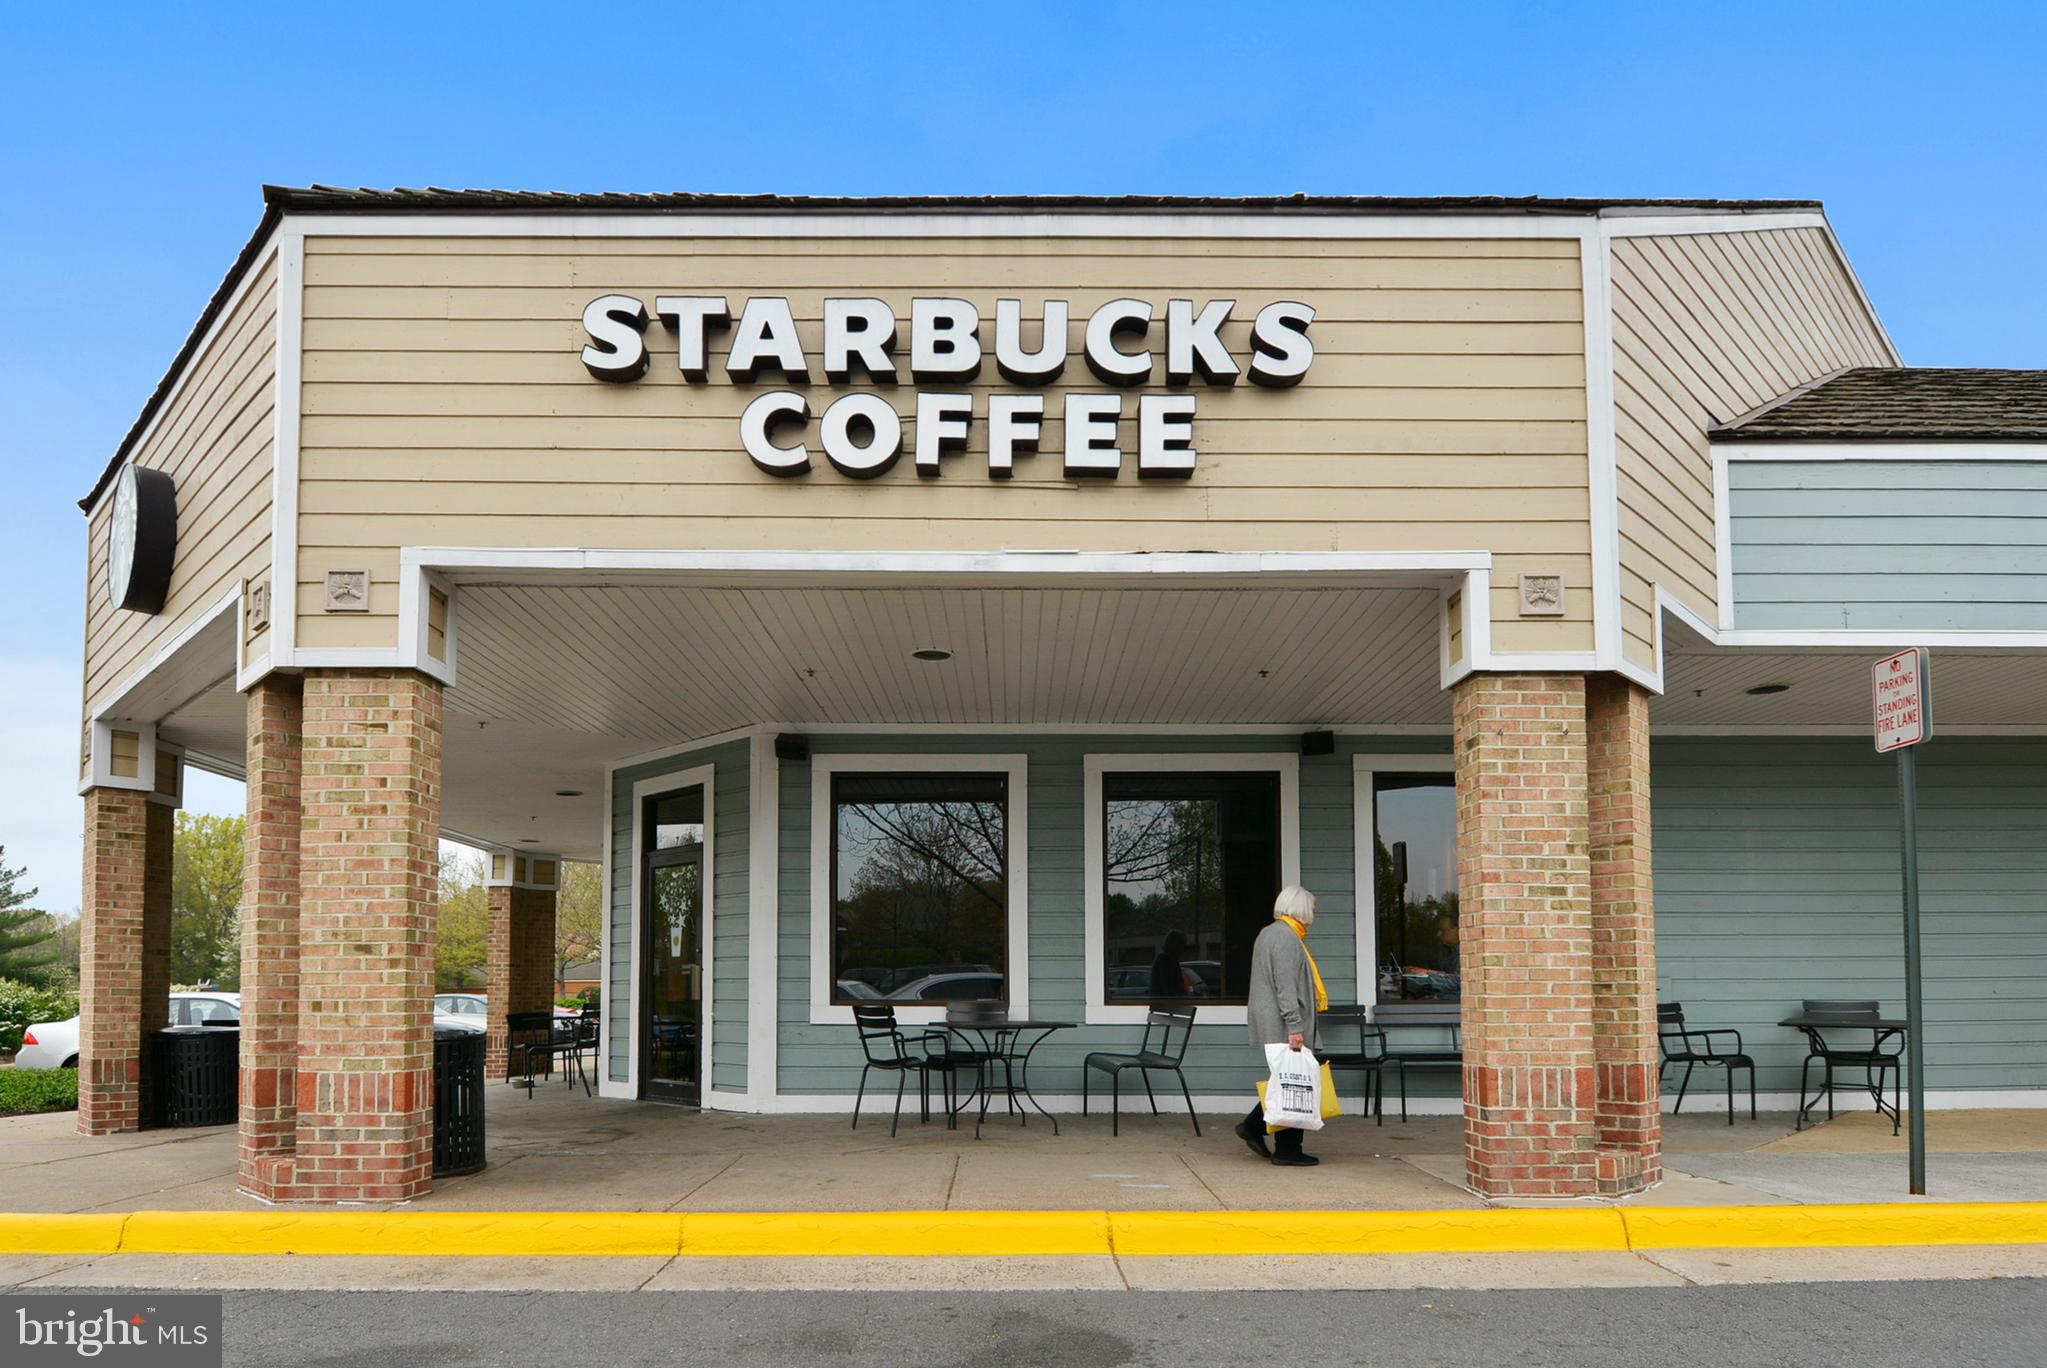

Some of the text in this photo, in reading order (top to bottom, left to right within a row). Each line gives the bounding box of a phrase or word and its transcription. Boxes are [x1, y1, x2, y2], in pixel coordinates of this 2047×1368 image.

[580, 294, 1317, 388] STARBUCKS
[739, 391, 1197, 479] COFFEE
[1890, 662, 1901, 674] NO
[1879, 672, 1913, 692] PARKING
[1878, 694, 1917, 715] STANDING
[1878, 709, 1917, 733] FIRE LANE
